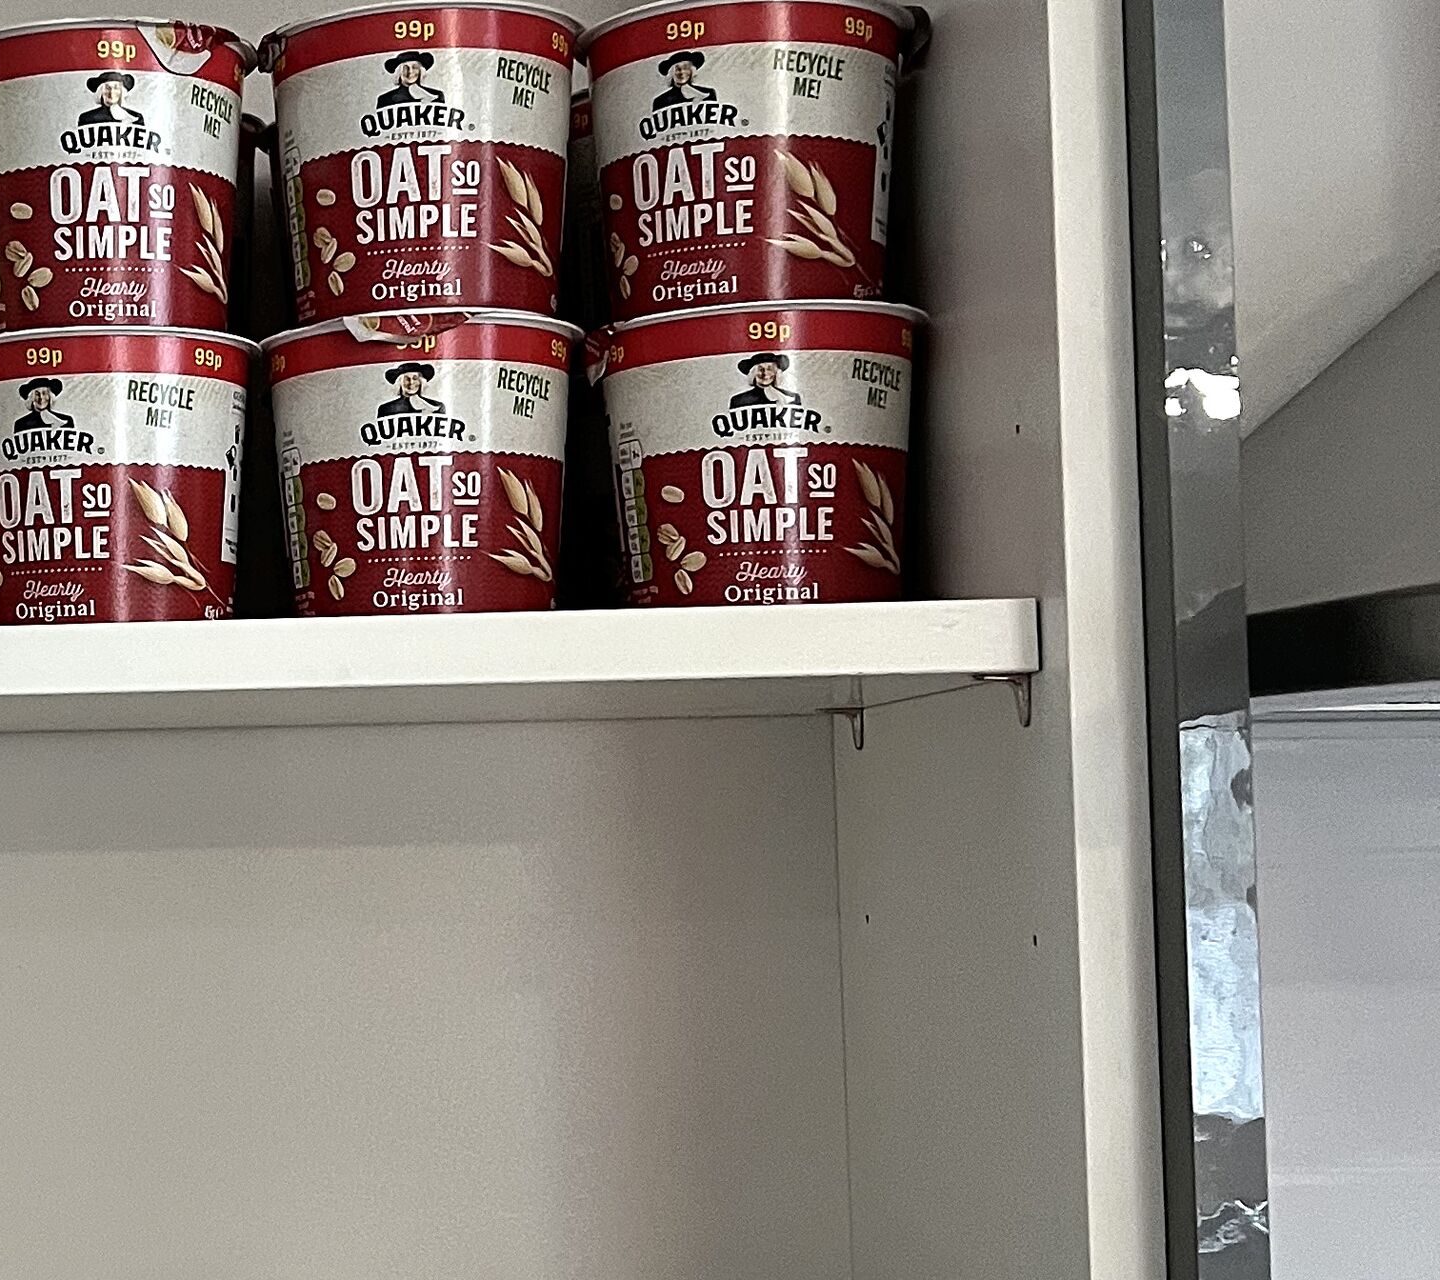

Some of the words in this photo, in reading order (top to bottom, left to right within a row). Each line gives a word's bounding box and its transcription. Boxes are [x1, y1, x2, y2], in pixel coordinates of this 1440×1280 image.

[394, 20, 435, 41] 99p
[667, 20, 705, 41] 99p
[845, 17, 873, 42] 99p
[97, 41, 136, 62] 99p
[497, 57, 551, 94] RECYCLE
[773, 49, 845, 81] RECYCLE
[511, 86, 535, 110] ME!
[793, 77, 821, 99] ME!
[191, 84, 232, 124] RECYCLE
[203, 115, 220, 139] ME!
[360, 105, 465, 137] QUAKER
[639, 104, 738, 141] QUAKER
[60, 125, 161, 155] QUAKER
[351, 145, 452, 208] OAT
[451, 161, 480, 186] SO
[633, 142, 725, 211] OAT
[725, 156, 755, 184] SO
[50, 167, 150, 224] OAT
[149, 184, 175, 210] SO
[356, 204, 478, 244] SIMPLE
[638, 199, 753, 247] SIMPLE
[54, 225, 172, 261] SIMPLE
[382, 259, 452, 281] Hearty
[660, 258, 726, 281] Hearty
[80, 277, 147, 301] Hearty
[372, 280, 462, 302] Original
[653, 276, 737, 301] Original
[69, 300, 157, 321] Original
[748, 321, 791, 342] 99p
[27, 348, 63, 367] 99p
[194, 348, 222, 370] 99p
[497, 367, 551, 401] RECYCLE
[852, 357, 901, 392] RECYCLE
[128, 380, 195, 411] RECYCLE
[512, 396, 535, 419] ME!
[867, 387, 887, 409] ME!
[146, 407, 173, 429] ME!
[360, 416, 466, 446] QUAKER
[712, 407, 822, 438] QUAKER
[2, 429, 94, 461] QUAKER
[351, 455, 452, 516] OAT
[451, 471, 481, 497] SO
[701, 447, 808, 508] OAT
[808, 463, 836, 489] SO
[82, 483, 111, 509] SO
[357, 514, 479, 551] SIMPLE
[707, 507, 834, 545] SIMPLE
[2, 527, 110, 564] SIMPLE
[384, 568, 451, 590] Hearty
[736, 562, 807, 582] Hearty
[24, 580, 84, 602] Hearty
[373, 589, 463, 610] Original
[725, 583, 818, 605] Original
[16, 600, 95, 622] Original
